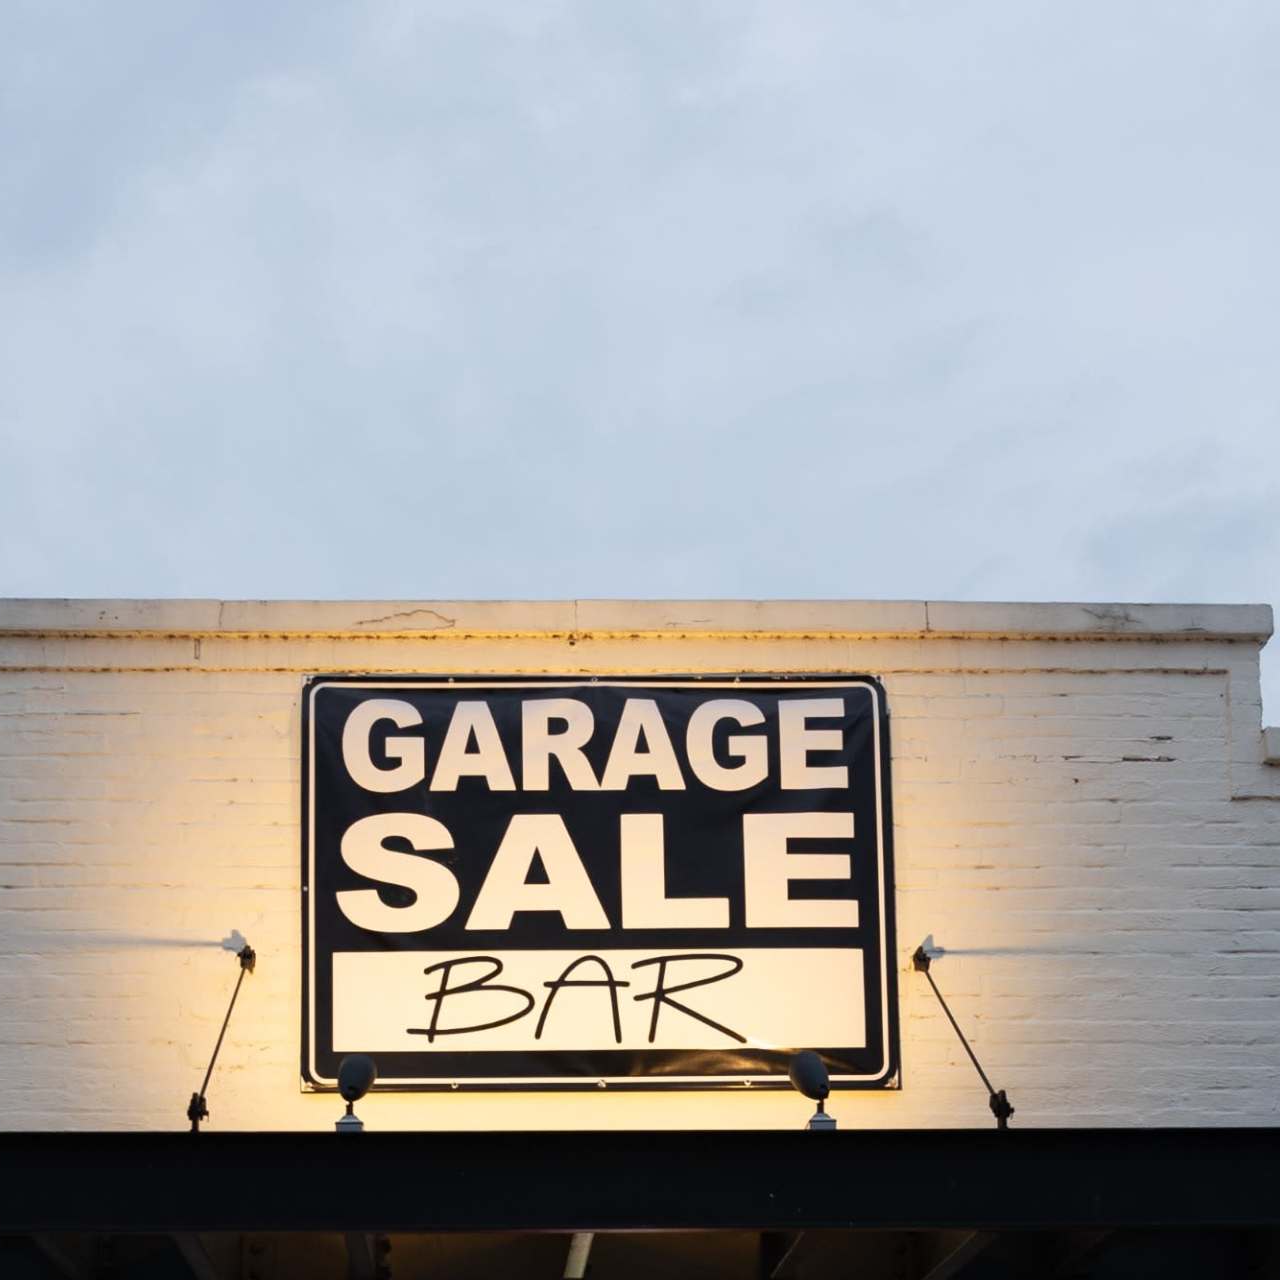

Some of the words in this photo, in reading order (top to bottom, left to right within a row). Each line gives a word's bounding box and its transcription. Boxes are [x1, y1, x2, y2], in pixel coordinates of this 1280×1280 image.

[341, 697, 849, 793] GARAGE
[335, 811, 860, 934] SALE
[406, 953, 748, 1044] BAR
